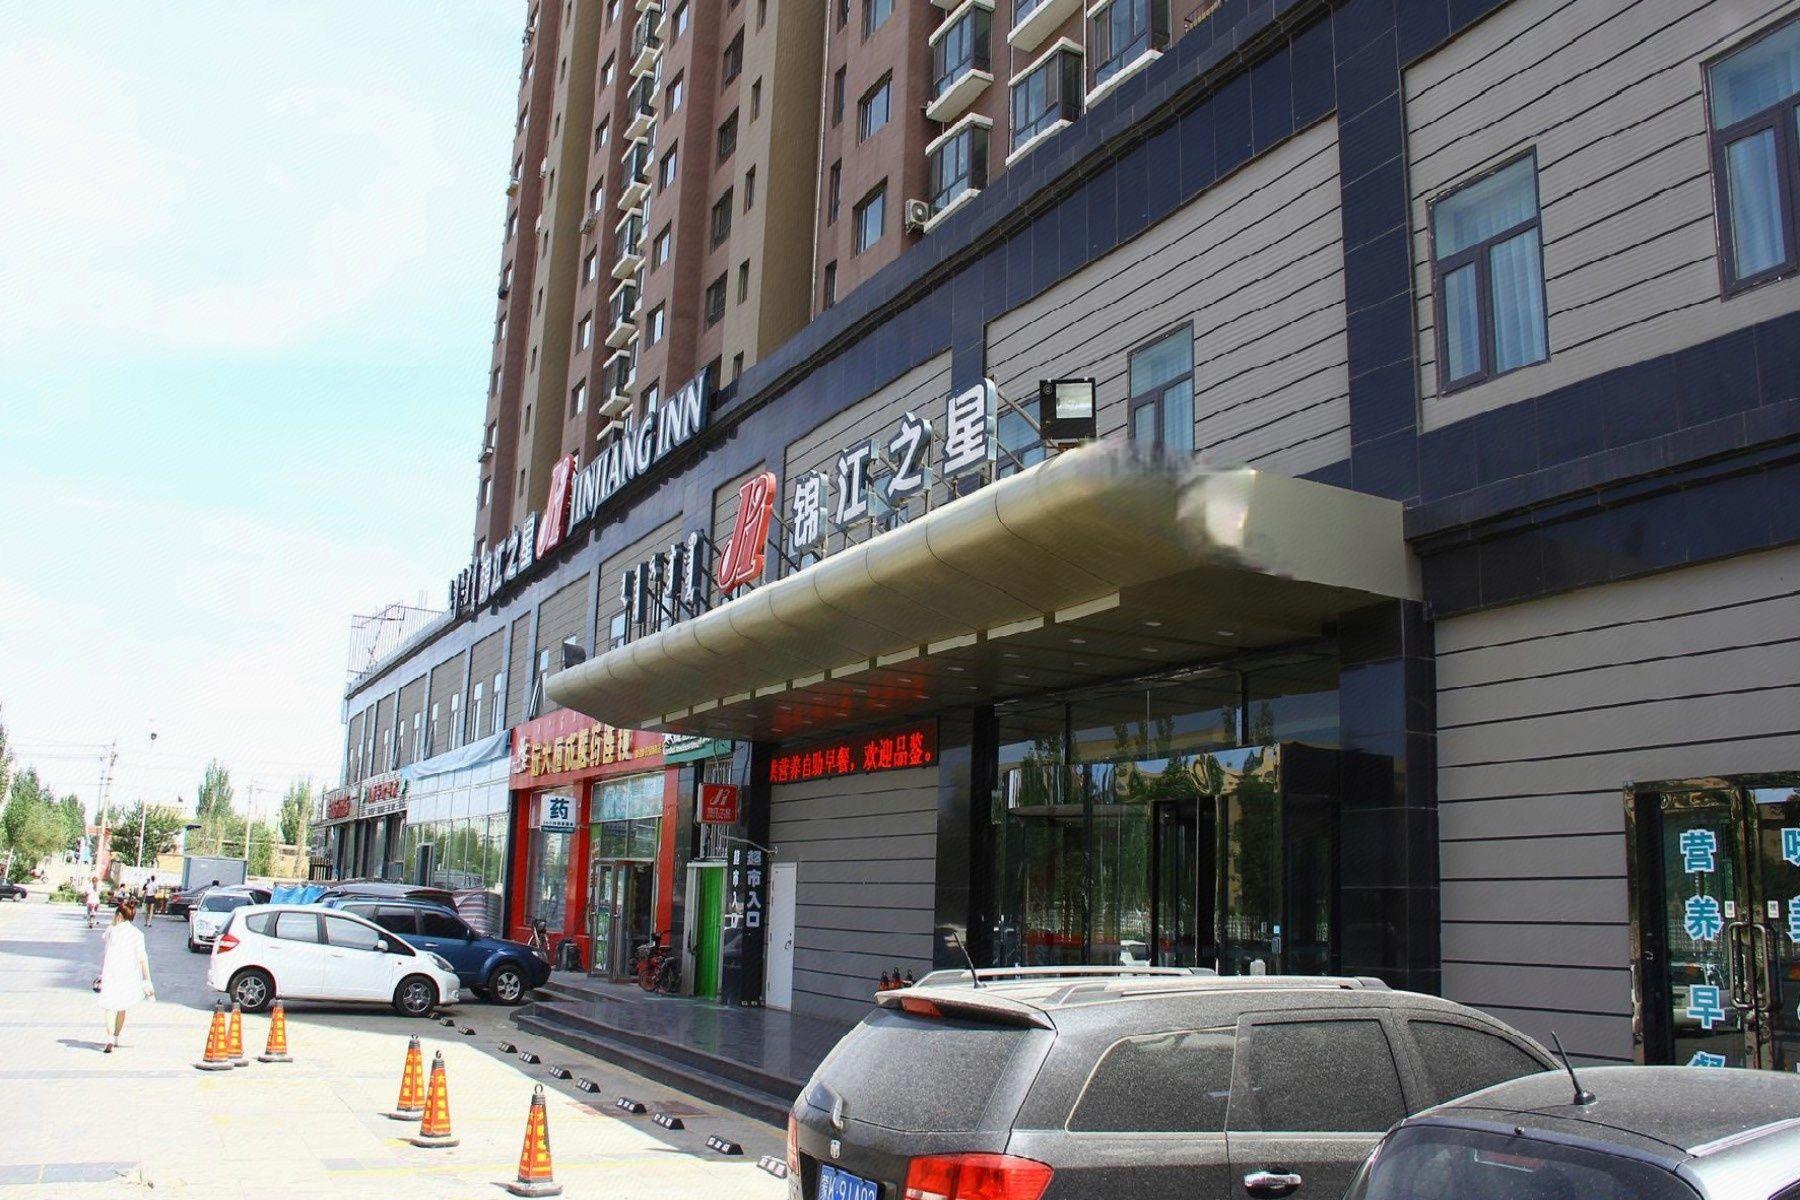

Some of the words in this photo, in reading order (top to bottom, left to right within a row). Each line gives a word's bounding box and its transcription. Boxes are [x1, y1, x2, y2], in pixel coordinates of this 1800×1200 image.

[567, 414, 656, 537] JINJIANG
[656, 368, 707, 461] INN
[793, 384, 986, 547] 锦江之星
[550, 798, 569, 819] 药
[746, 850, 762, 928] 超市入口
